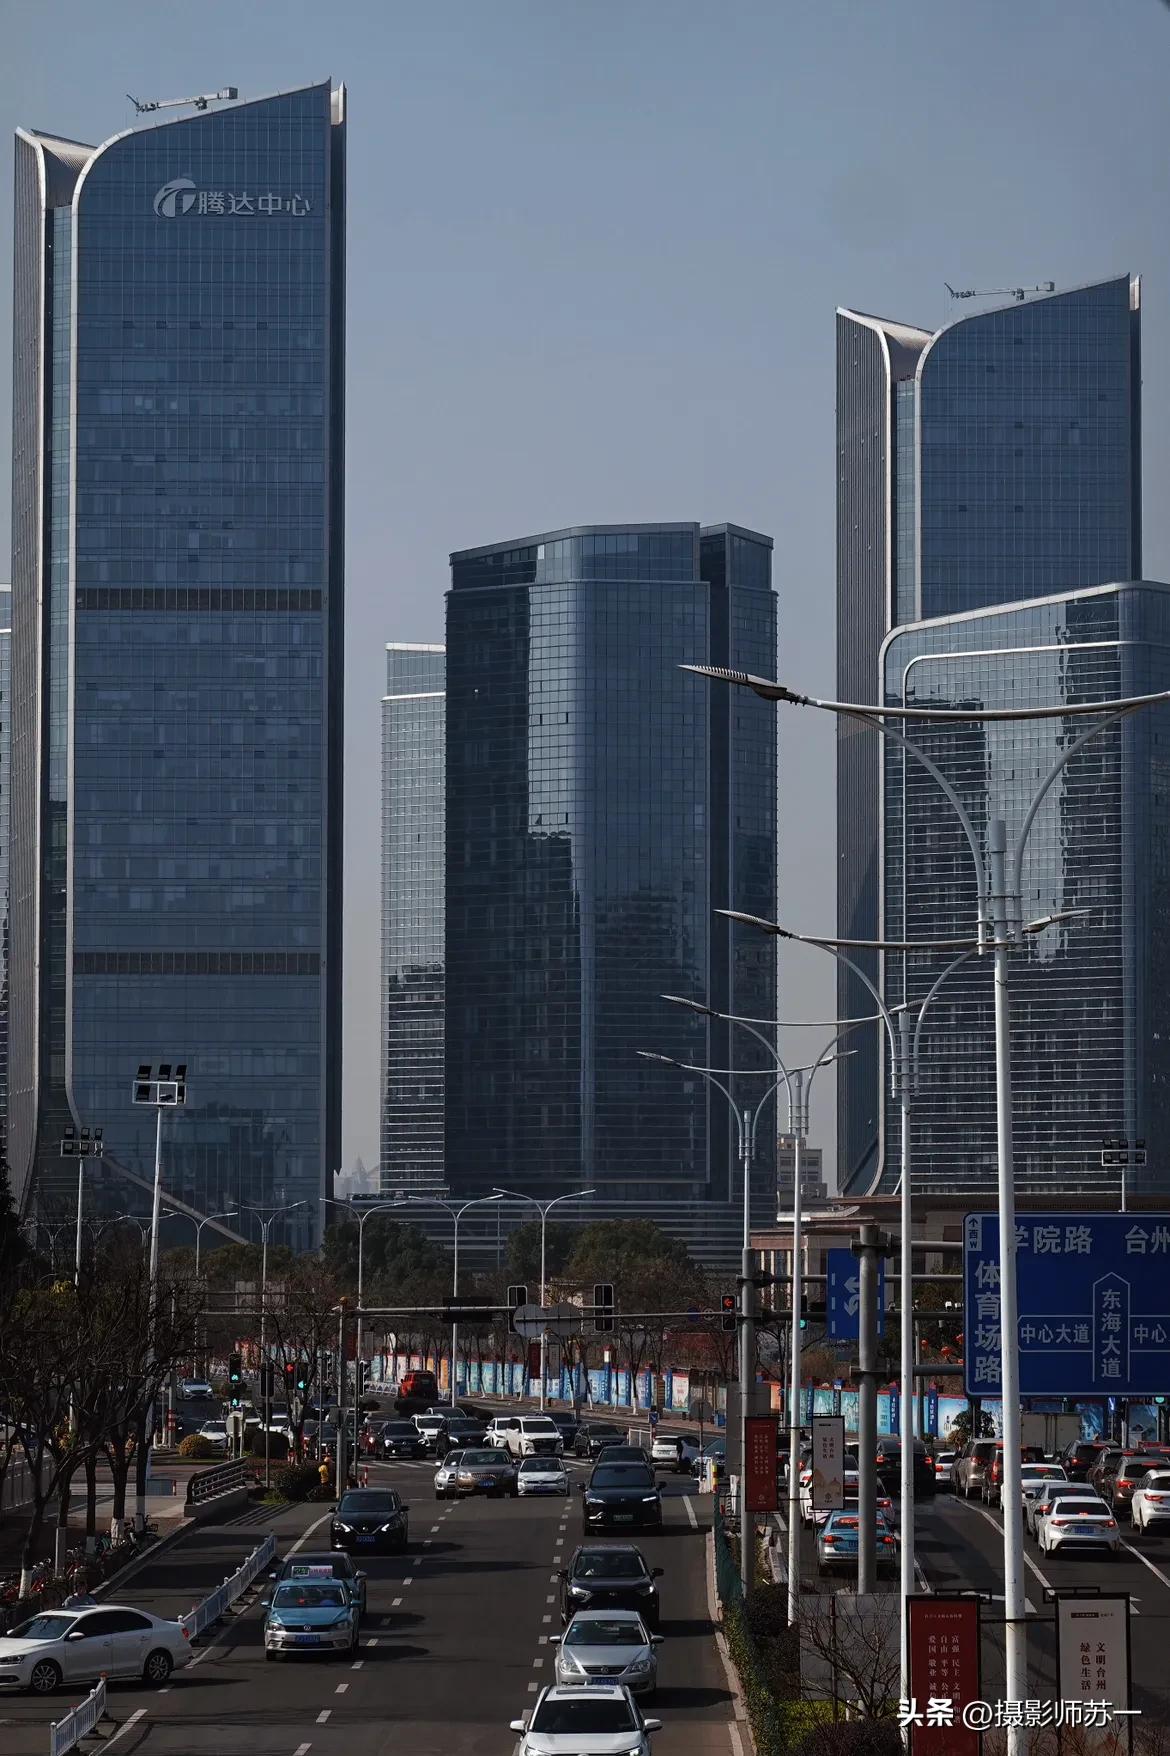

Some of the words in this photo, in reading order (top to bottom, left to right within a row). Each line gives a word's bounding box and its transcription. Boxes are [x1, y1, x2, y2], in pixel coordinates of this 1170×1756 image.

[198, 191, 311, 216] 腾达中心
[969, 1229, 979, 1240] 西
[969, 1241, 978, 1249] W
[1124, 1225, 1170, 1254] 台州
[974, 1260, 1002, 1384] 体育场路
[1020, 1323, 1091, 1345] 中心大道
[1101, 1289, 1122, 1379] 东海大道
[1134, 1323, 1170, 1345] 中心
[1080, 1642, 1091, 1690] 绿色生活
[1095, 1641, 1107, 1690] 文明台州
